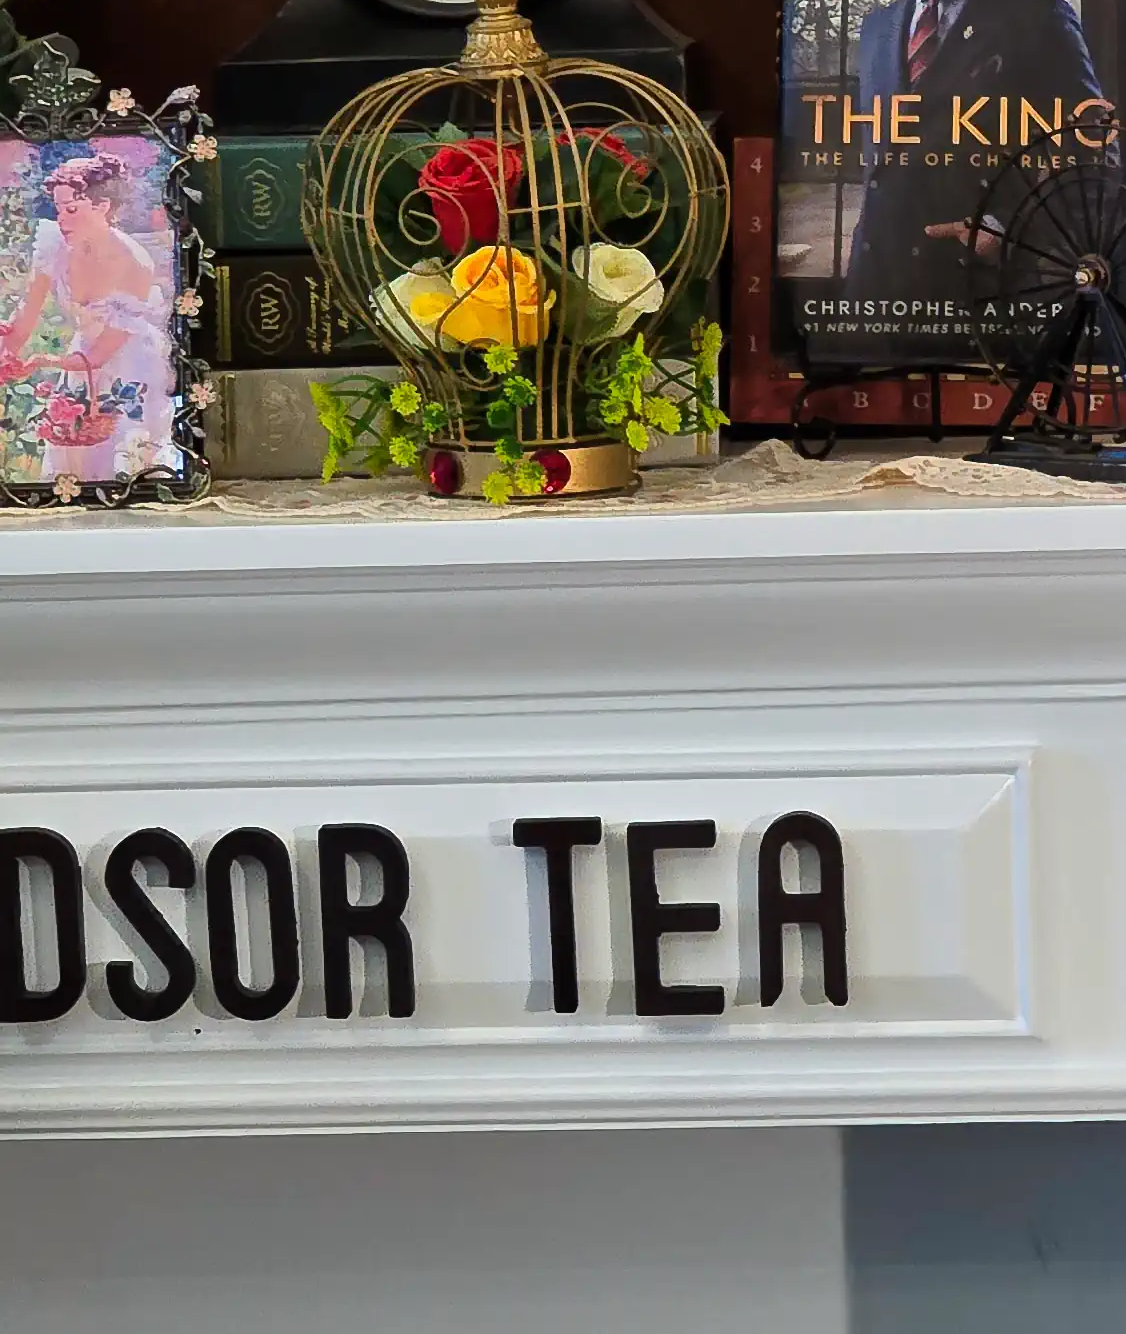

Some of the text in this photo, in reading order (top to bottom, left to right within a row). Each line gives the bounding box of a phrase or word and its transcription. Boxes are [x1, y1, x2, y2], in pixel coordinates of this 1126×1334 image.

[801, 95, 1121, 149] THE KING
[750, 156, 763, 174] 4
[800, 151, 843, 167] THE
[859, 152, 910, 167] LIFE
[925, 153, 955, 167] OF
[970, 153, 1077, 169] CHRLES
[252, 181, 272, 218] RW
[750, 216, 762, 233] 3
[748, 277, 761, 293] 2
[260, 294, 281, 331] RW
[826, 322, 858, 334] NEW
[864, 322, 901, 334] YORK
[907, 323, 949, 334] TIMES
[749, 335, 758, 352] 1
[852, 391, 869, 408] B
[912, 393, 930, 409] C
[973, 393, 993, 410] D
[1031, 392, 1047, 411] E
[1089, 394, 1105, 412] F
[513, 811, 848, 1016] TEA
